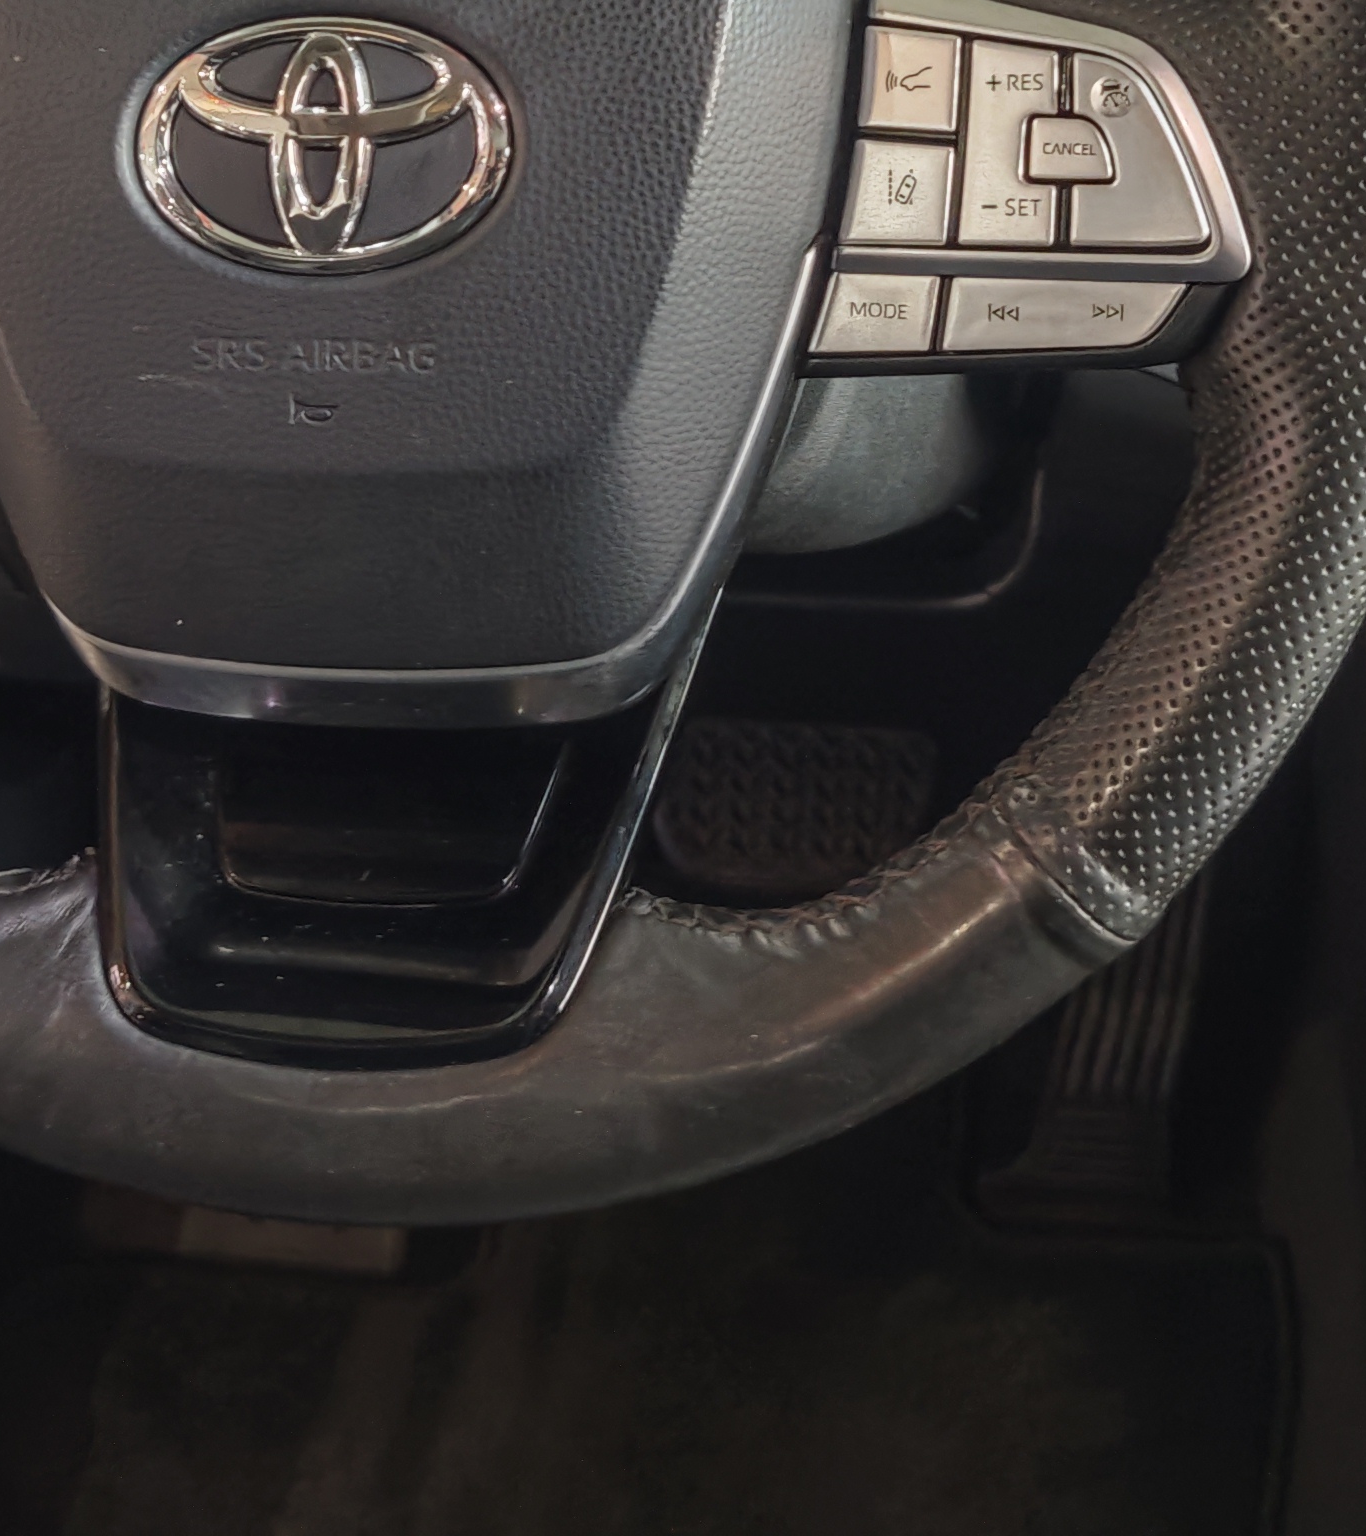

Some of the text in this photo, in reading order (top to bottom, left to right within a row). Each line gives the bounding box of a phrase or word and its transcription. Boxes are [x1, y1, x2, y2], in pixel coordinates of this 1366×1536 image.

[1042, 142, 1097, 157] CANCEL
[849, 301, 909, 320] MODE
[191, 337, 437, 375] SRS AIRBAG
